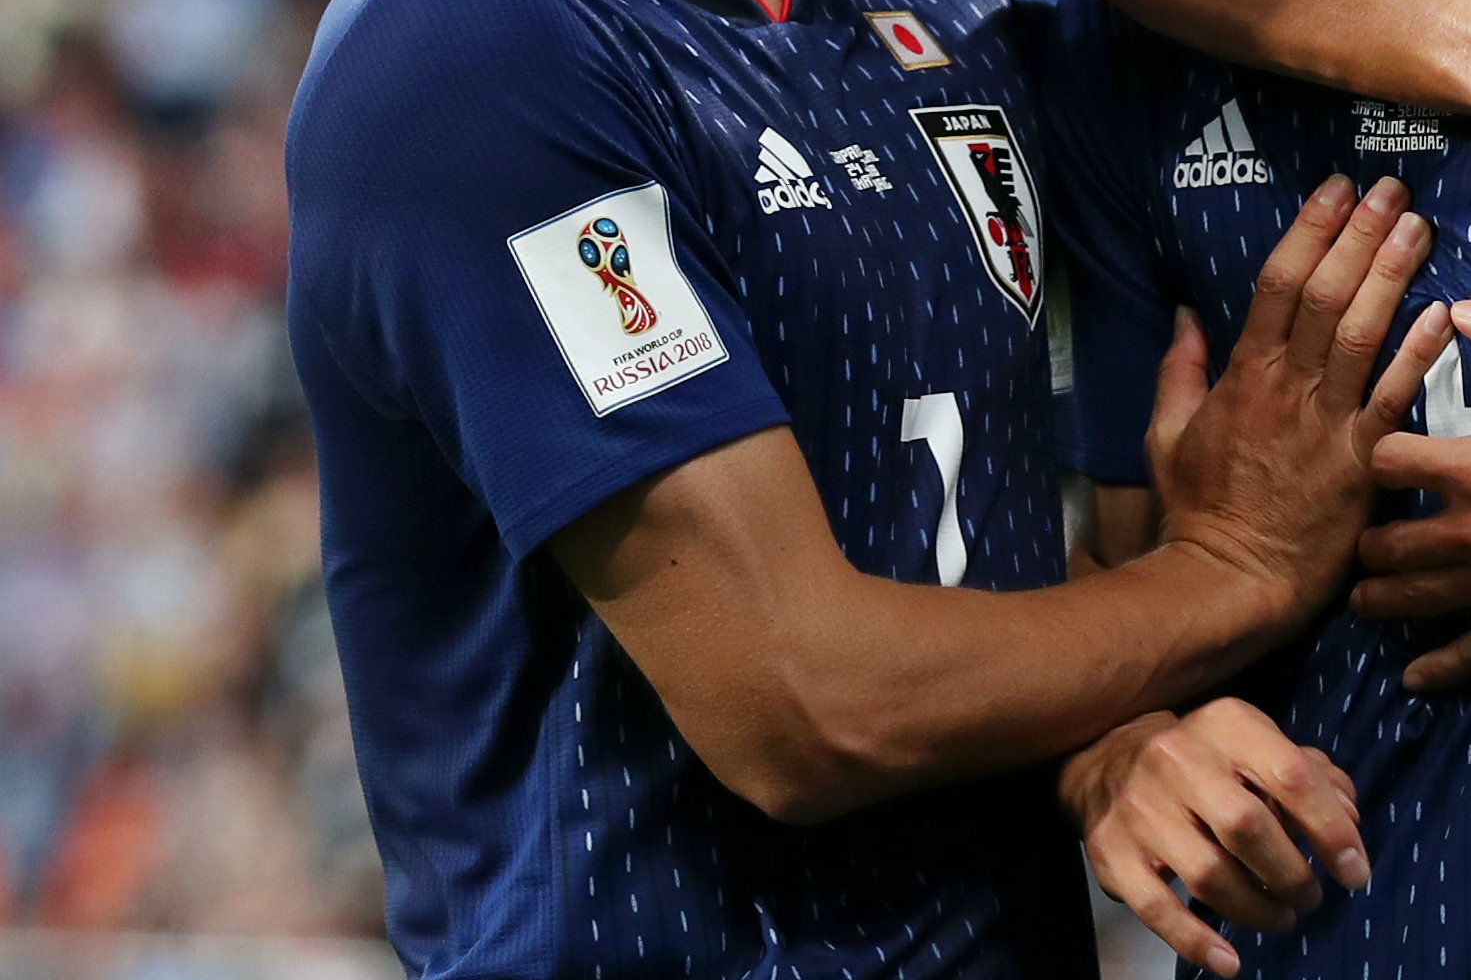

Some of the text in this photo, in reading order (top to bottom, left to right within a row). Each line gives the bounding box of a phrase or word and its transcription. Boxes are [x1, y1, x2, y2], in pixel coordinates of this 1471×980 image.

[942, 114, 992, 131] JAPAN
[1361, 118, 1440, 135] 24 JUNE 2018
[1173, 152, 1269, 188] adidas
[593, 332, 713, 396] RUSSIA 2018
[612, 328, 684, 366] FIFA WORLD CUP
